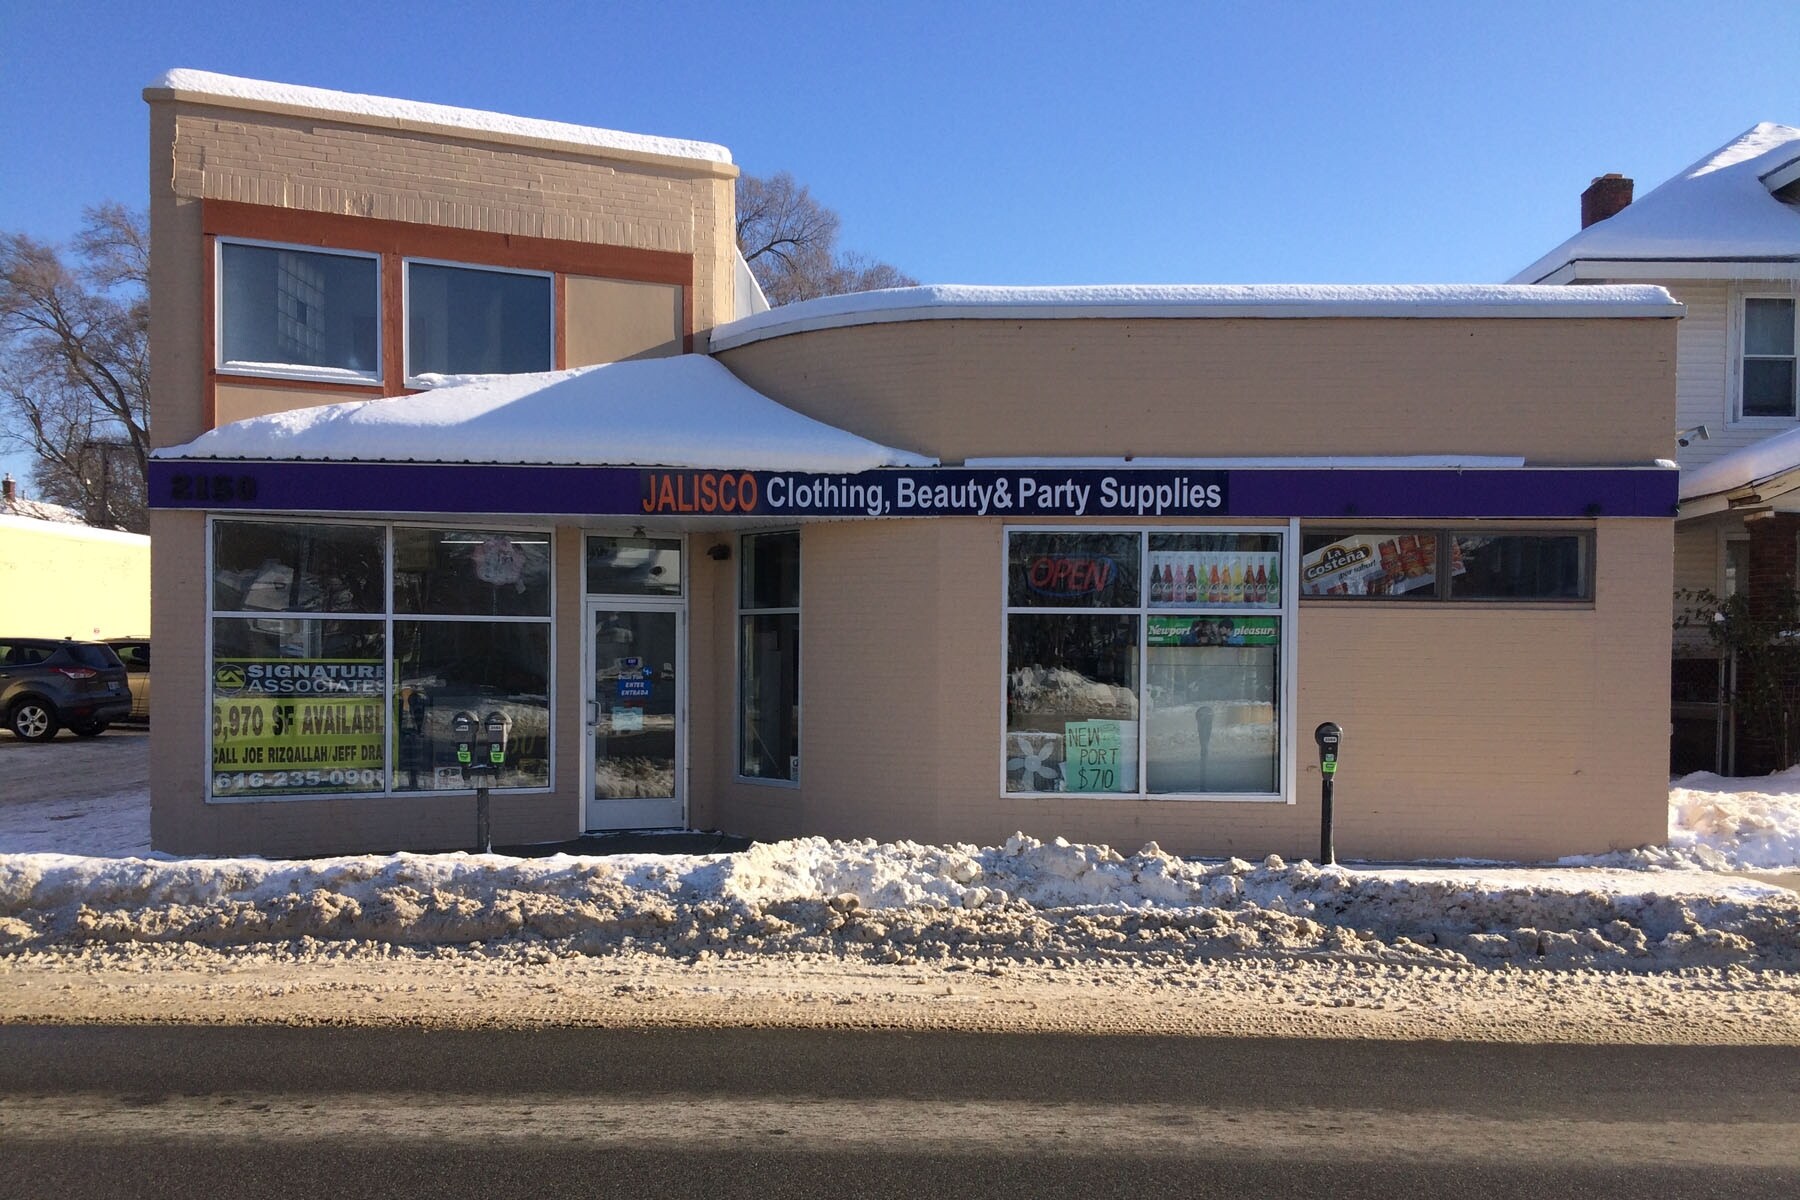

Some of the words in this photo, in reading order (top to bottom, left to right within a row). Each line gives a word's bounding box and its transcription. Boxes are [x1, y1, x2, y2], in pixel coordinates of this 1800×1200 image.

[171, 475, 257, 501] 2150
[642, 473, 758, 513] JALISCO
[766, 476, 891, 516] Clothing,
[1019, 477, 1090, 516] Party
[1100, 476, 1222, 516] Supplies
[1326, 549, 1342, 560] La
[1029, 557, 1110, 592] OPEN
[1148, 624, 1191, 637] Newport
[272, 705, 295, 736] SF
[302, 704, 384, 736] AVAILABL
[1068, 727, 1101, 747] NEW
[242, 747, 263, 763] JOE
[1079, 747, 1119, 767] PORT
